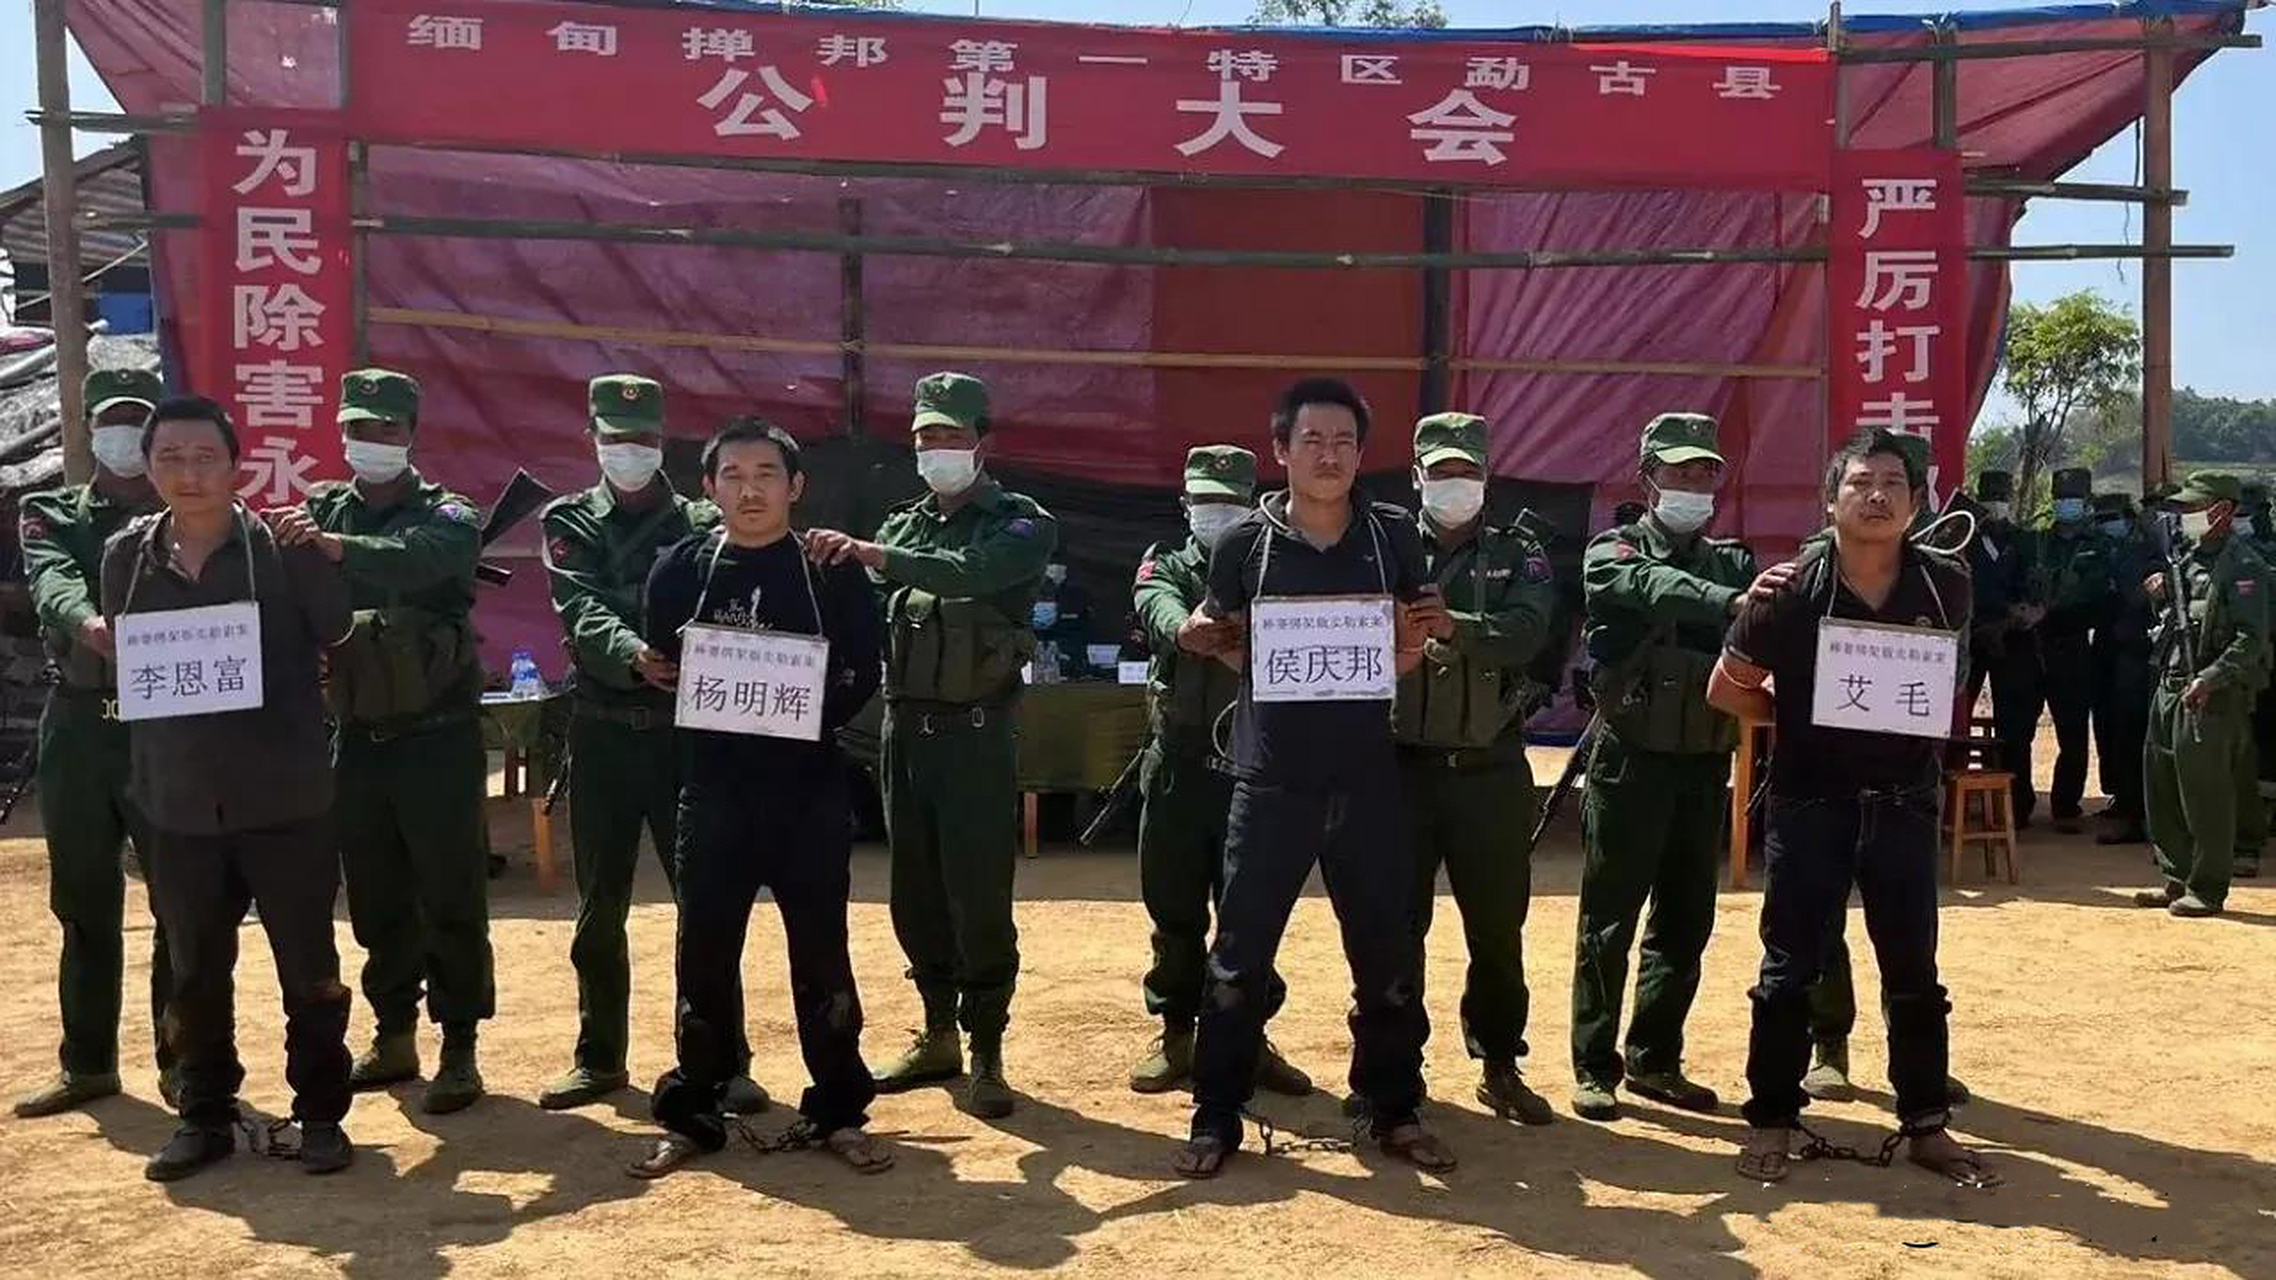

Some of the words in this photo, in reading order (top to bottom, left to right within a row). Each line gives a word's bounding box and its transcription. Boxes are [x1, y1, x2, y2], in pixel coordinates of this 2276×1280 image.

[407, 14, 1781, 100] 缅甸掸邦第一特区勐古县
[697, 65, 1518, 166] 公判大会
[232, 128, 326, 504] 为民除害永
[1855, 178, 1941, 514] 严厉打击
[130, 655, 247, 700] 李恩富
[692, 675, 810, 721] 杨明辉
[1266, 645, 1383, 685] 侯庆邦
